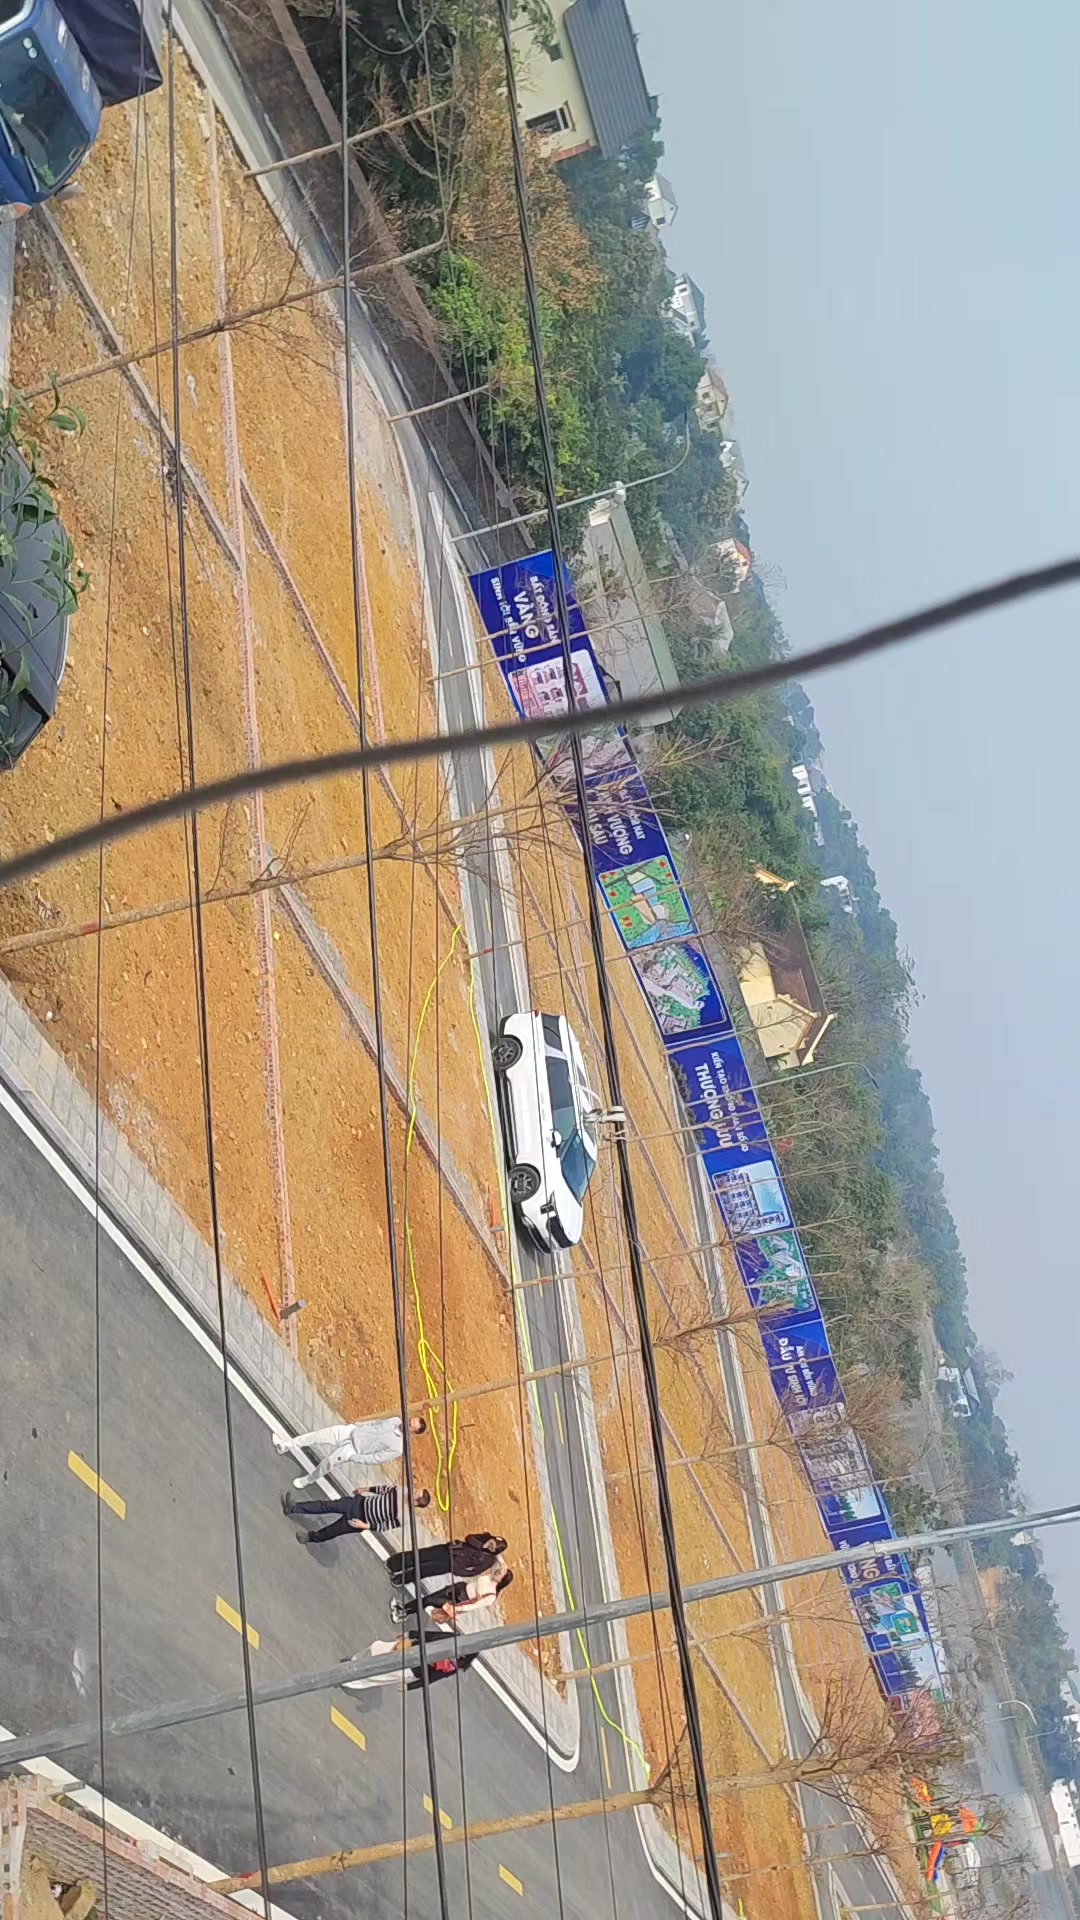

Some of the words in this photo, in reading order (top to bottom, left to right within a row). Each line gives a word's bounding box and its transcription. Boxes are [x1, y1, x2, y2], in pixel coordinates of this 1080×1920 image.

[514, 591, 539, 638] VÀNG
[589, 823, 608, 845] SAU
[607, 814, 633, 855] VƯỢNG
[633, 825, 646, 840] NAY
[716, 1069, 726, 1084] TẠO
[695, 1062, 723, 1120] THƯỢNG
[779, 1337, 794, 1361] ĐẦU
